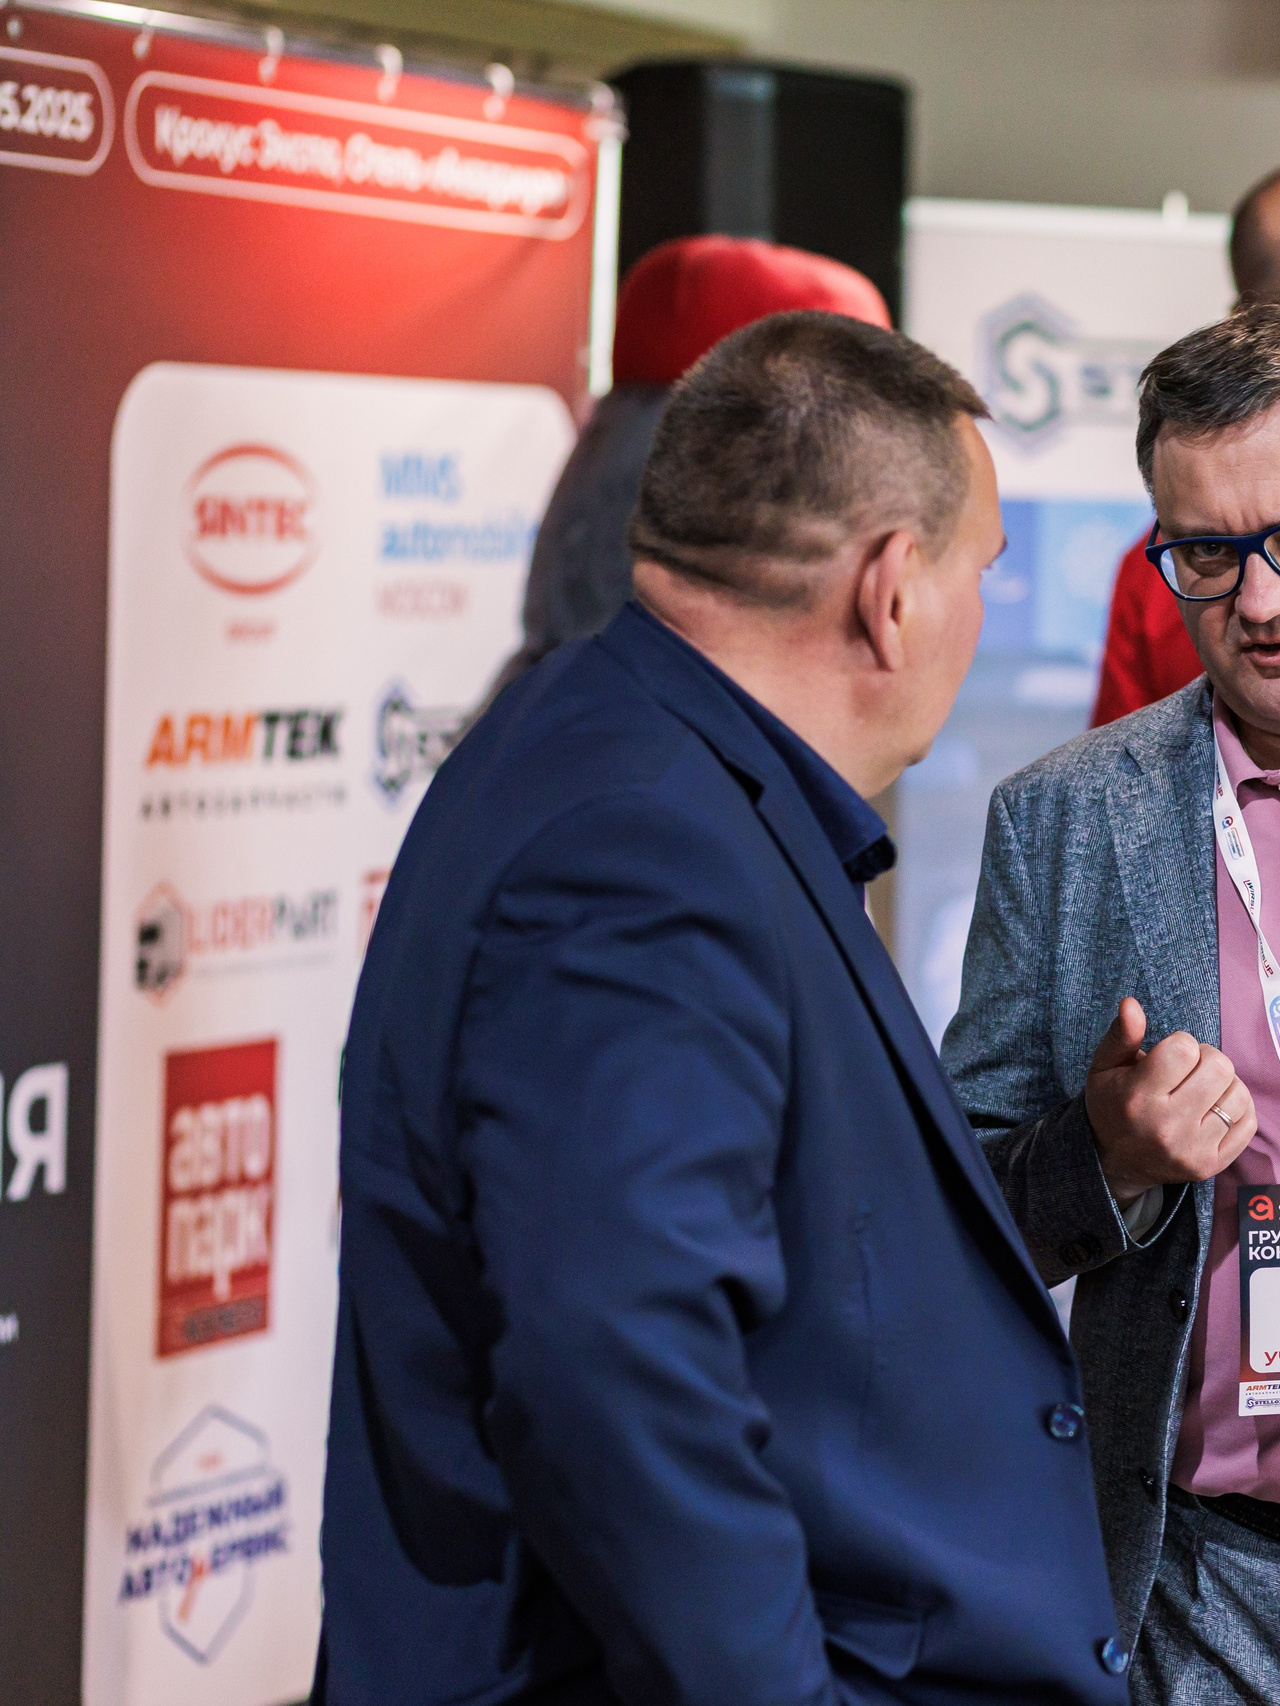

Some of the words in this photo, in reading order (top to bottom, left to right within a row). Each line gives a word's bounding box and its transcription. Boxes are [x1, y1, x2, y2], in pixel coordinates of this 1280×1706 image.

[193, 495, 307, 543] SINTEC
[144, 709, 347, 770] ARMTEK
[0, 1062, 69, 1201] Я
